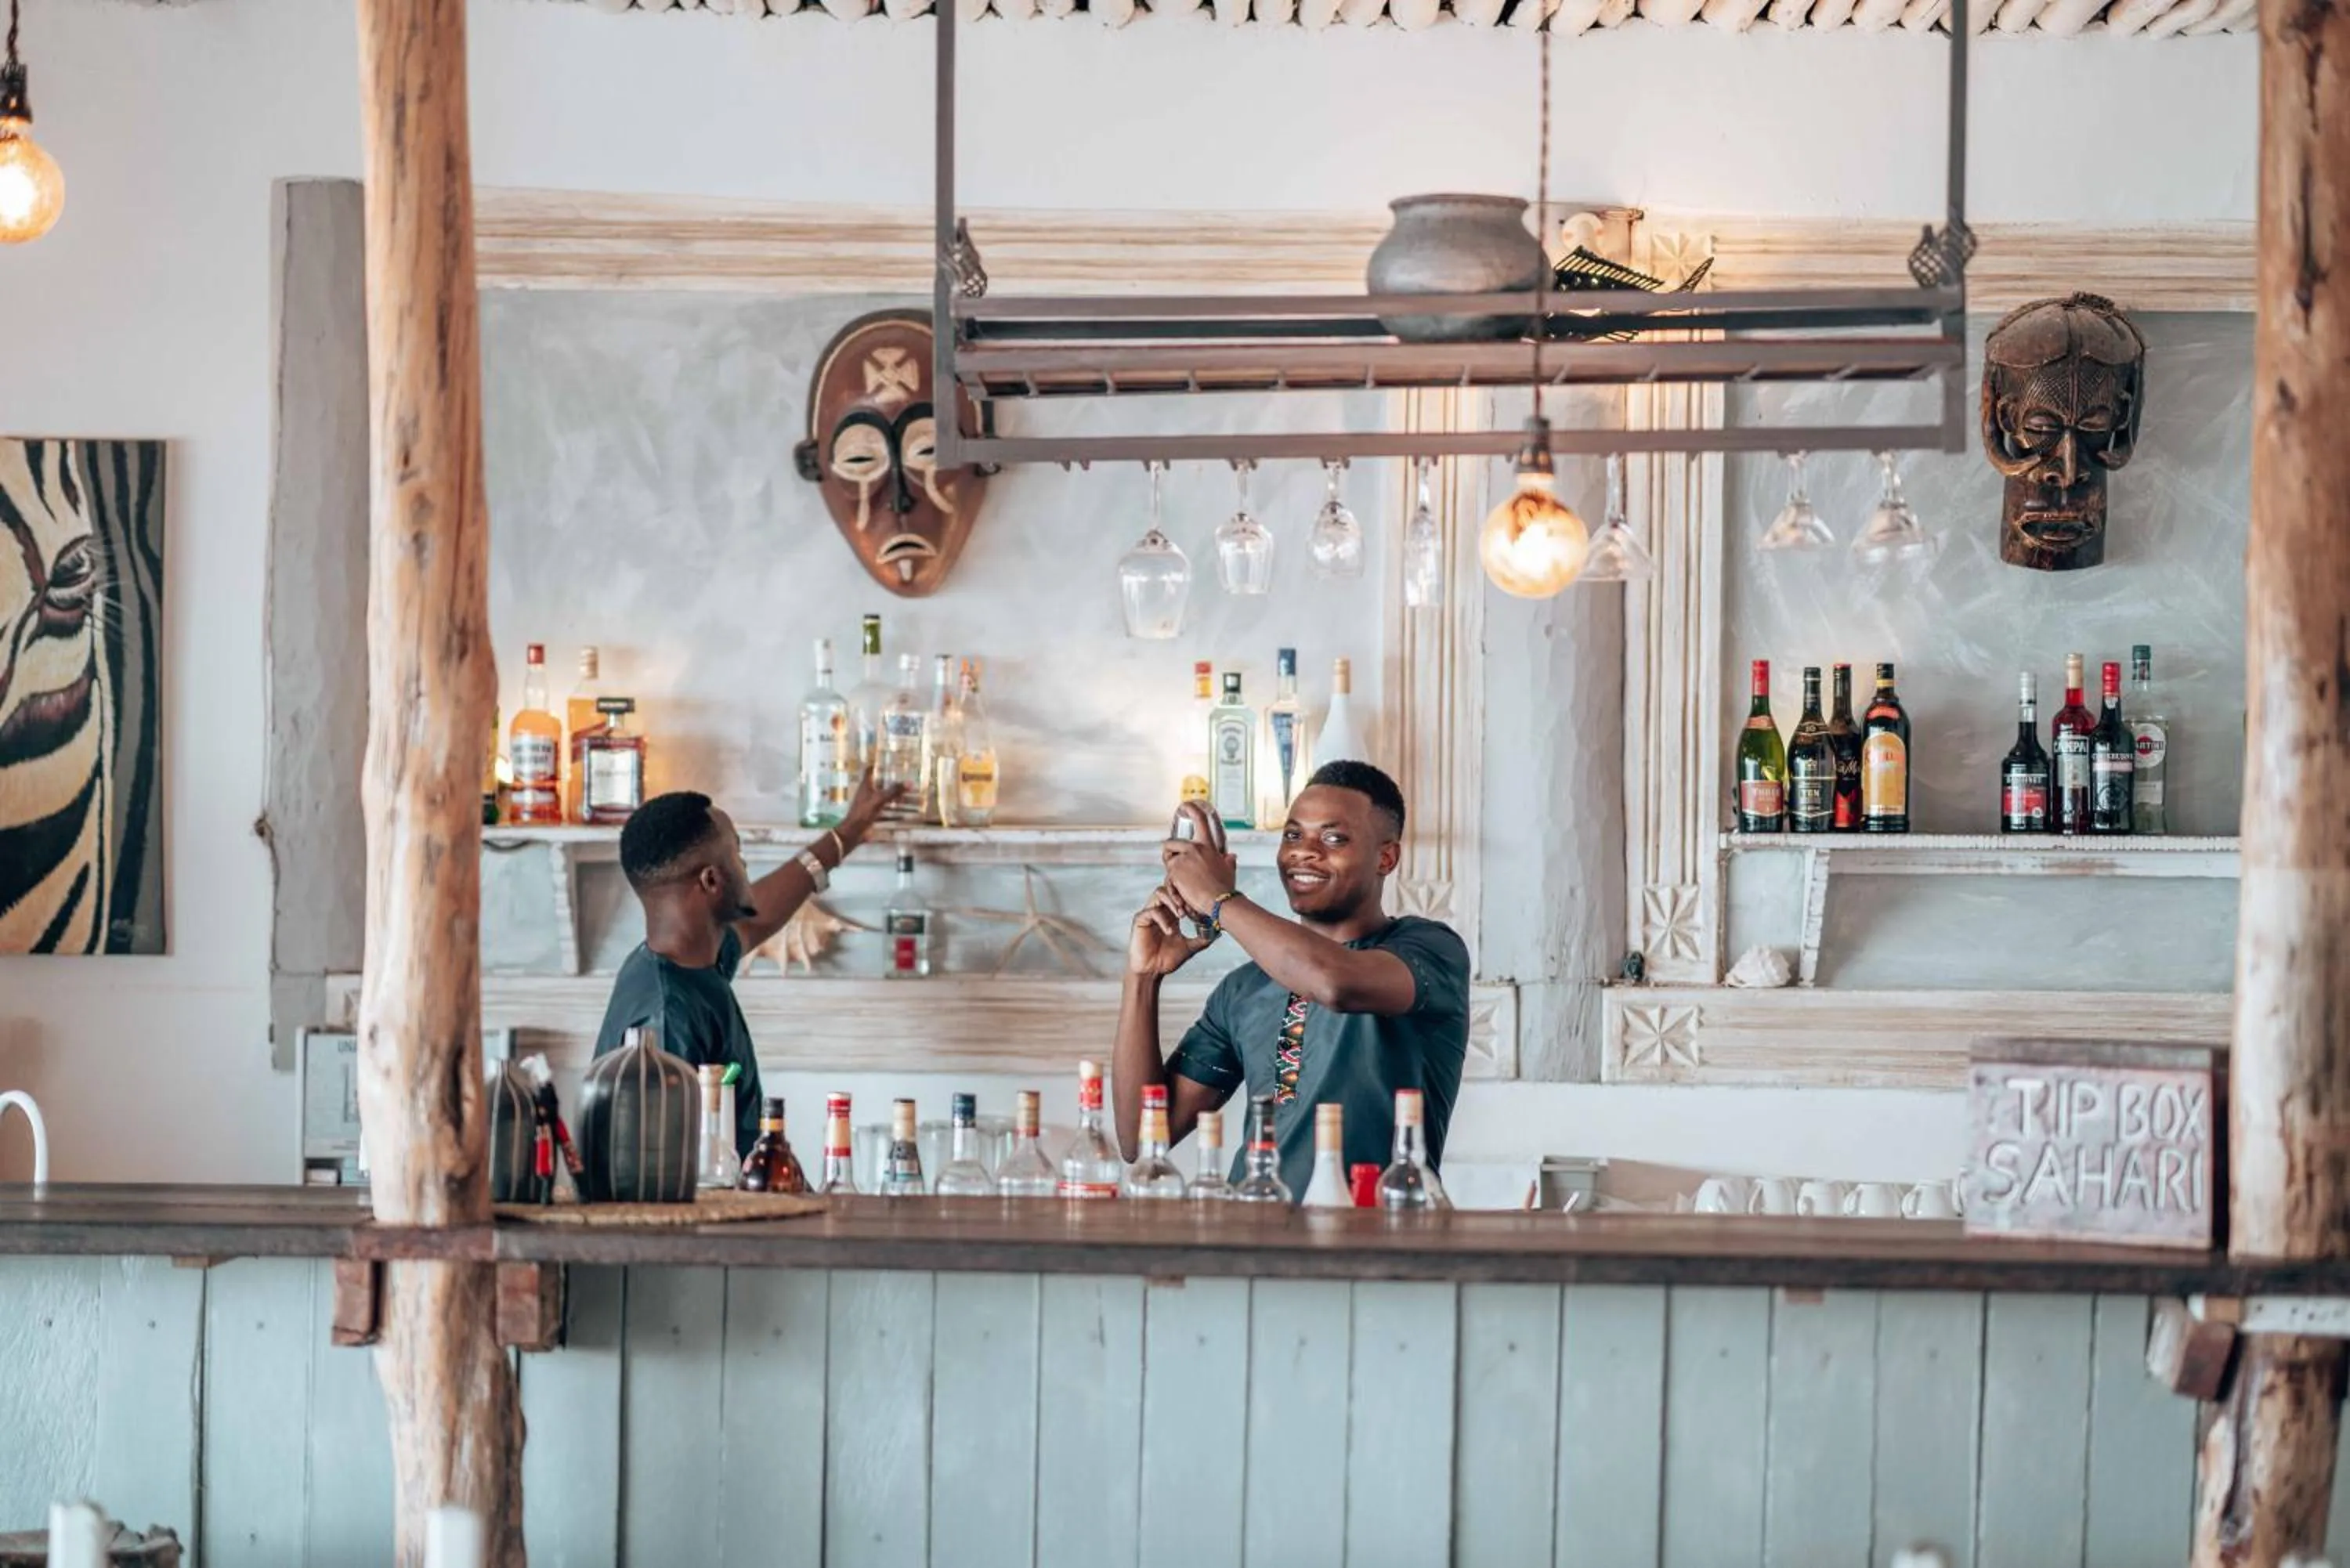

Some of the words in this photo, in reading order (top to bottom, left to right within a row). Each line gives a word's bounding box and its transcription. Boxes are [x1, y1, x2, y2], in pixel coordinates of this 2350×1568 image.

[2135, 741, 2164, 750] ARTINI
[2003, 1077, 2105, 1140] TIP
[2116, 1082, 2205, 1144] BOX
[1982, 1140, 2204, 1212] SAHARI
